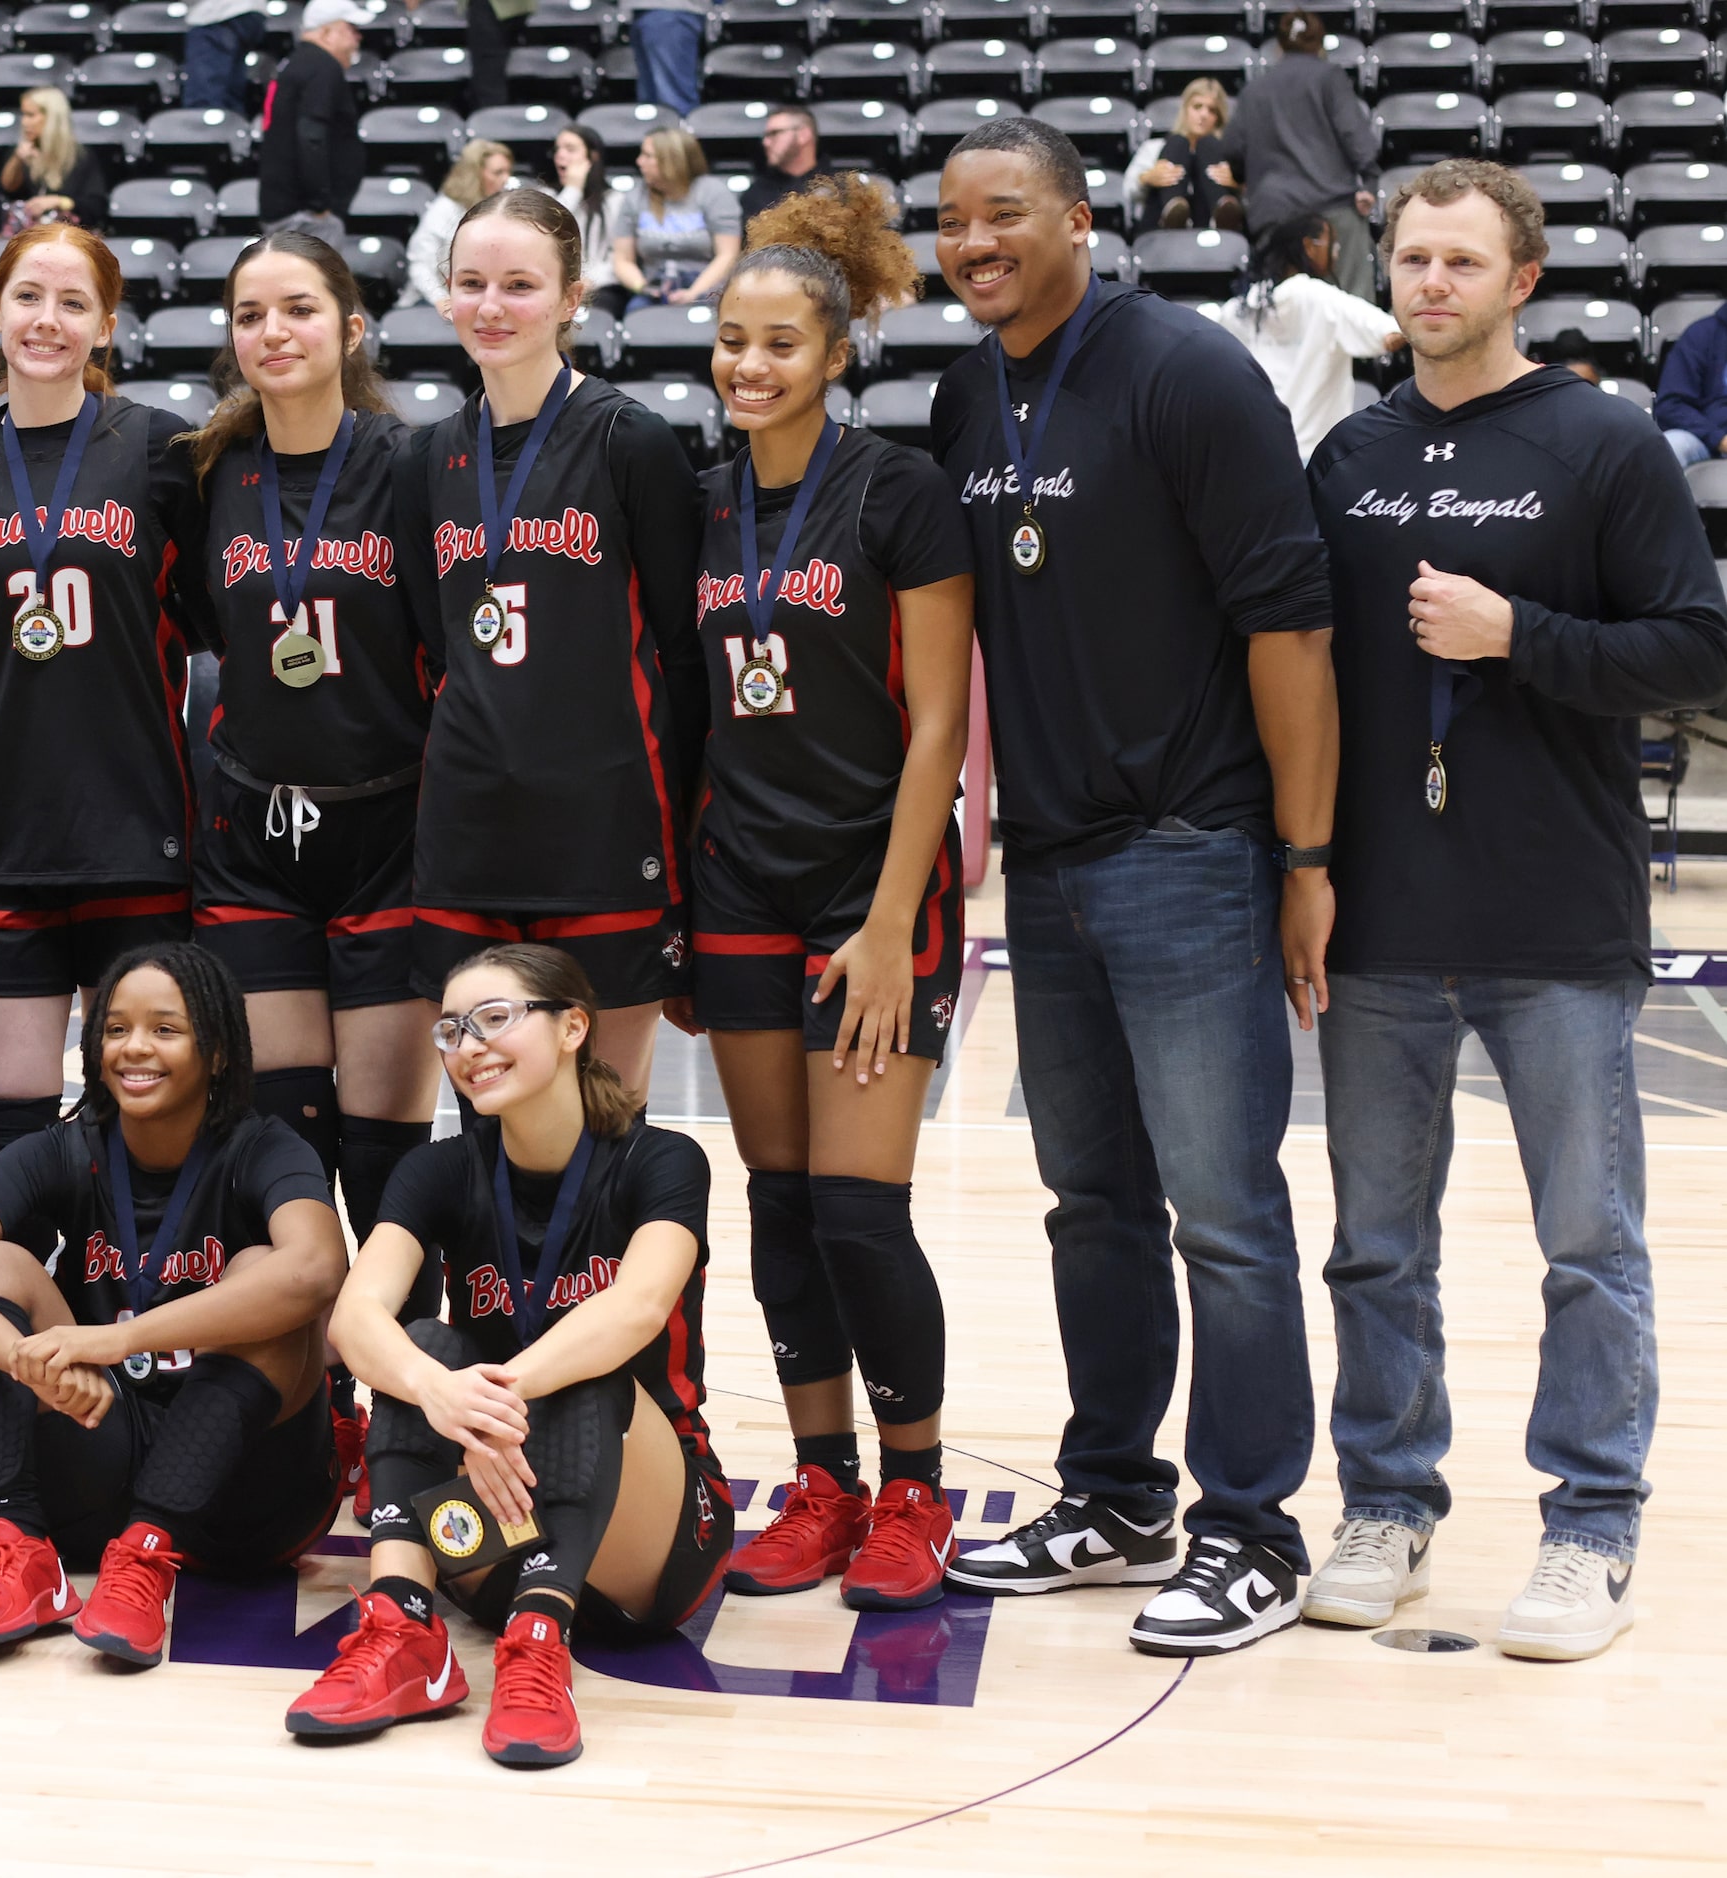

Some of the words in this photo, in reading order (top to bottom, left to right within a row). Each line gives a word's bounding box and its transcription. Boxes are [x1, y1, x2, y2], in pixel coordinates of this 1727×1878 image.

[1345, 488, 1419, 526] Lady
[1427, 488, 1544, 527] Bengals
[489, 581, 528, 667] 5
